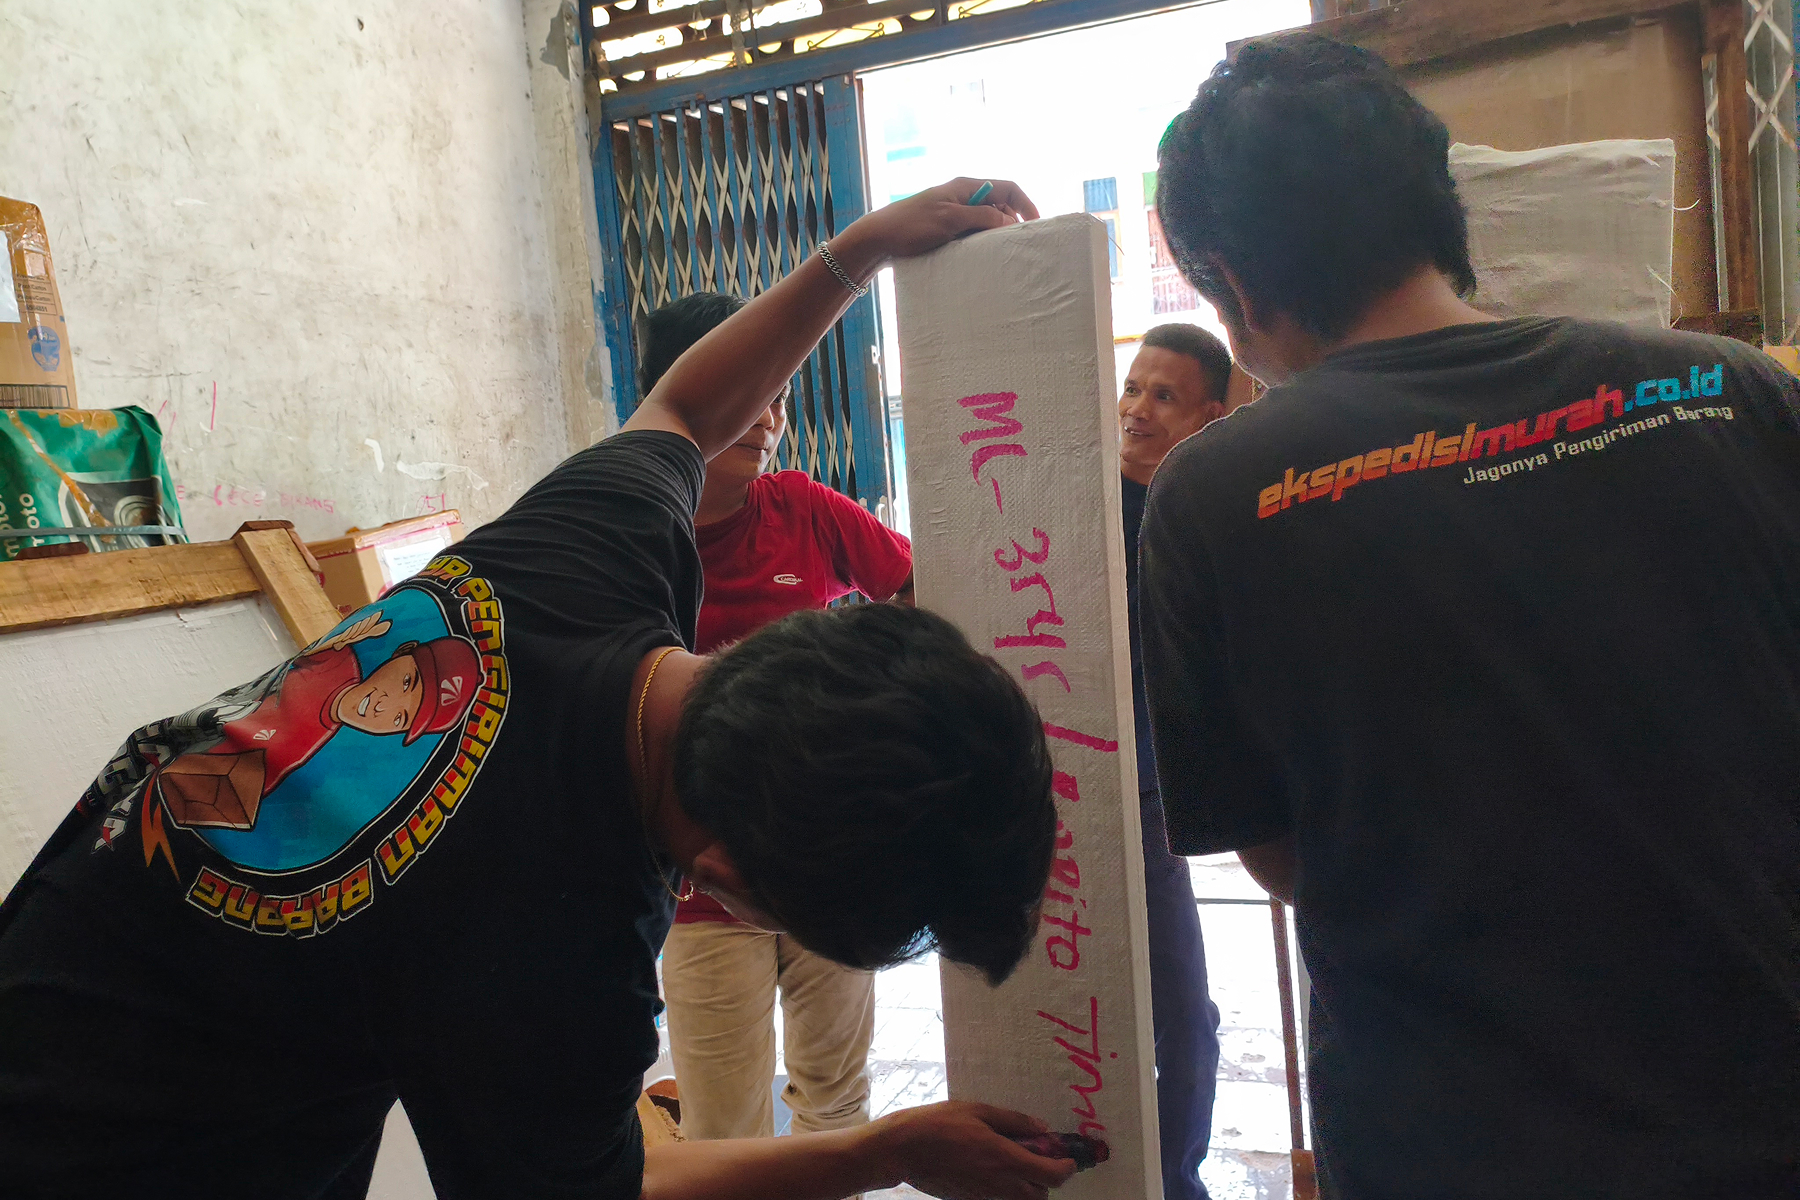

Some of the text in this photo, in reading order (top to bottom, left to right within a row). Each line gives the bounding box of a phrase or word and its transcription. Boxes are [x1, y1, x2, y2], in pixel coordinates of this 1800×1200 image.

[1463, 404, 1734, 485] Jagonya Pengiriman Barang
[189, 863, 372, 936] BARANG
